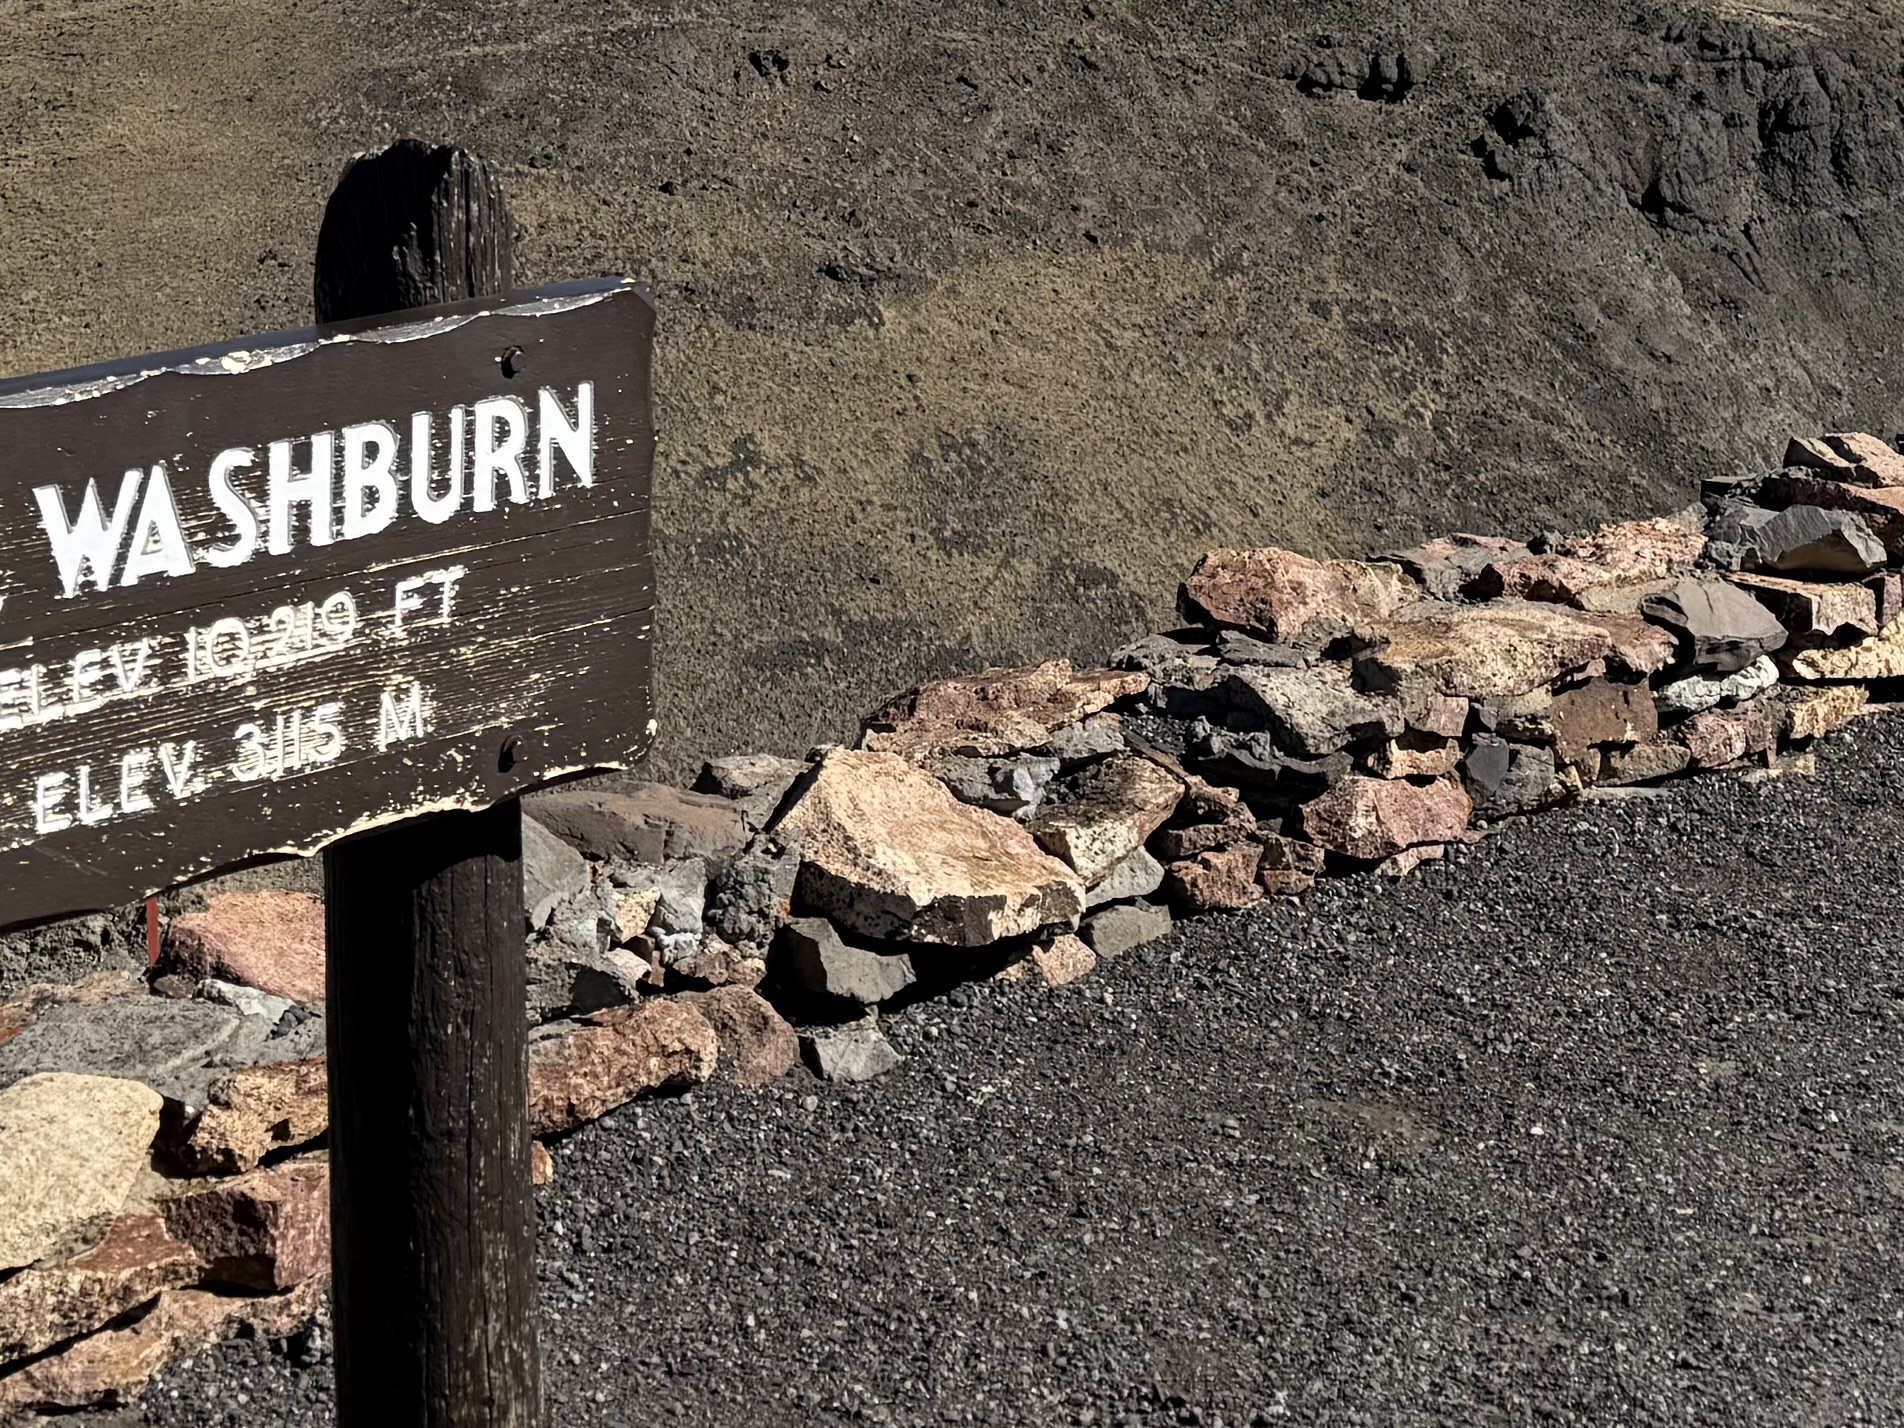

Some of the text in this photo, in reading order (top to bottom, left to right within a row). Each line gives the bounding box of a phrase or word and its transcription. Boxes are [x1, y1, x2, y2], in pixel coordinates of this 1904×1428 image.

[33, 380, 596, 599] WASHBURN
[394, 567, 466, 636] FT
[35, 682, 428, 834] ELEV 3115 M
